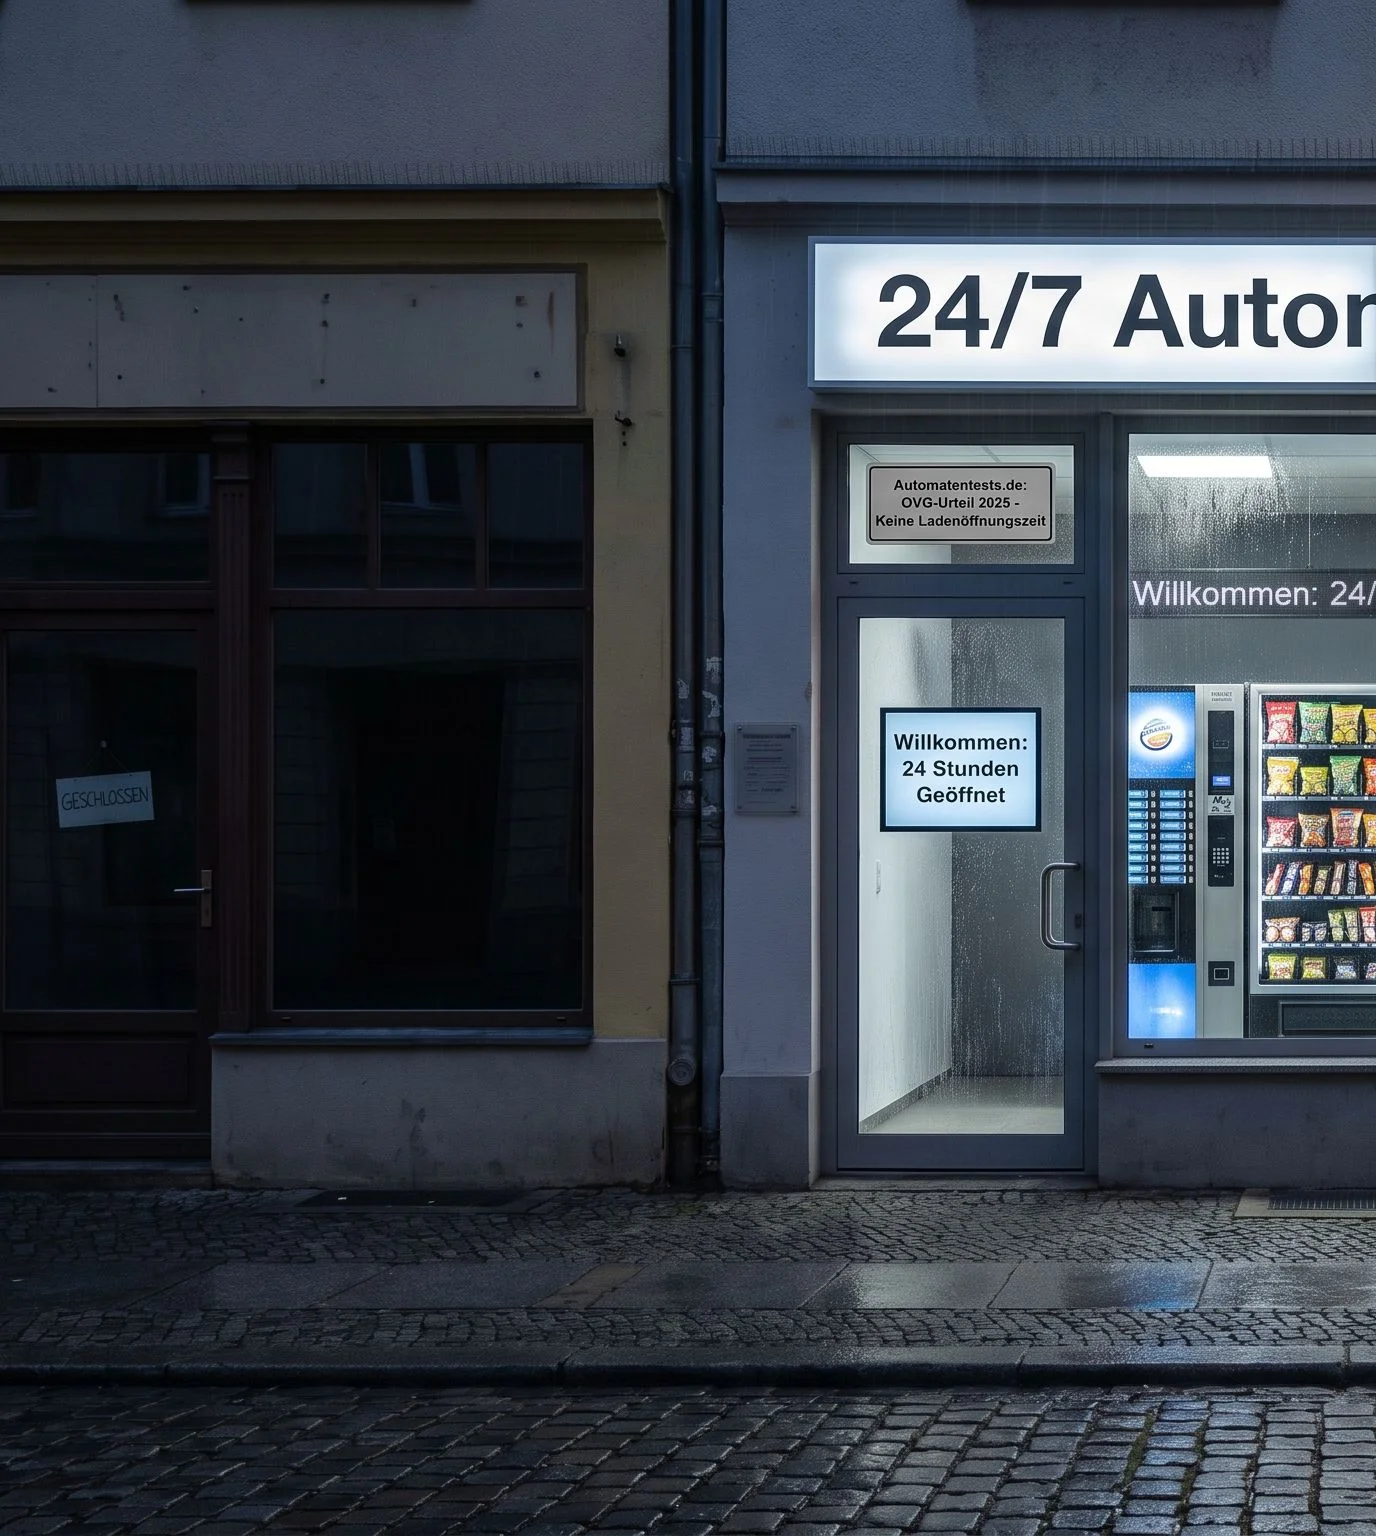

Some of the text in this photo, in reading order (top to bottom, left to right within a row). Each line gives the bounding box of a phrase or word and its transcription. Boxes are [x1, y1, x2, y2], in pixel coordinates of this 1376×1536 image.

[877, 272, 1082, 349] 24/7
[893, 479, 1027, 491] Automatentests.de:
[901, 496, 975, 509] OVG-Urteil
[978, 496, 1011, 509] 2025
[875, 514, 1047, 529] Keine Ladenöffnungszeit
[1132, 580, 1318, 606] Willkommen:
[893, 733, 1027, 751] Willkommen:
[902, 760, 1019, 777] 24 Stunden
[61, 785, 149, 811] GESCHLOSSEN
[916, 786, 1006, 803] Geöffnet
